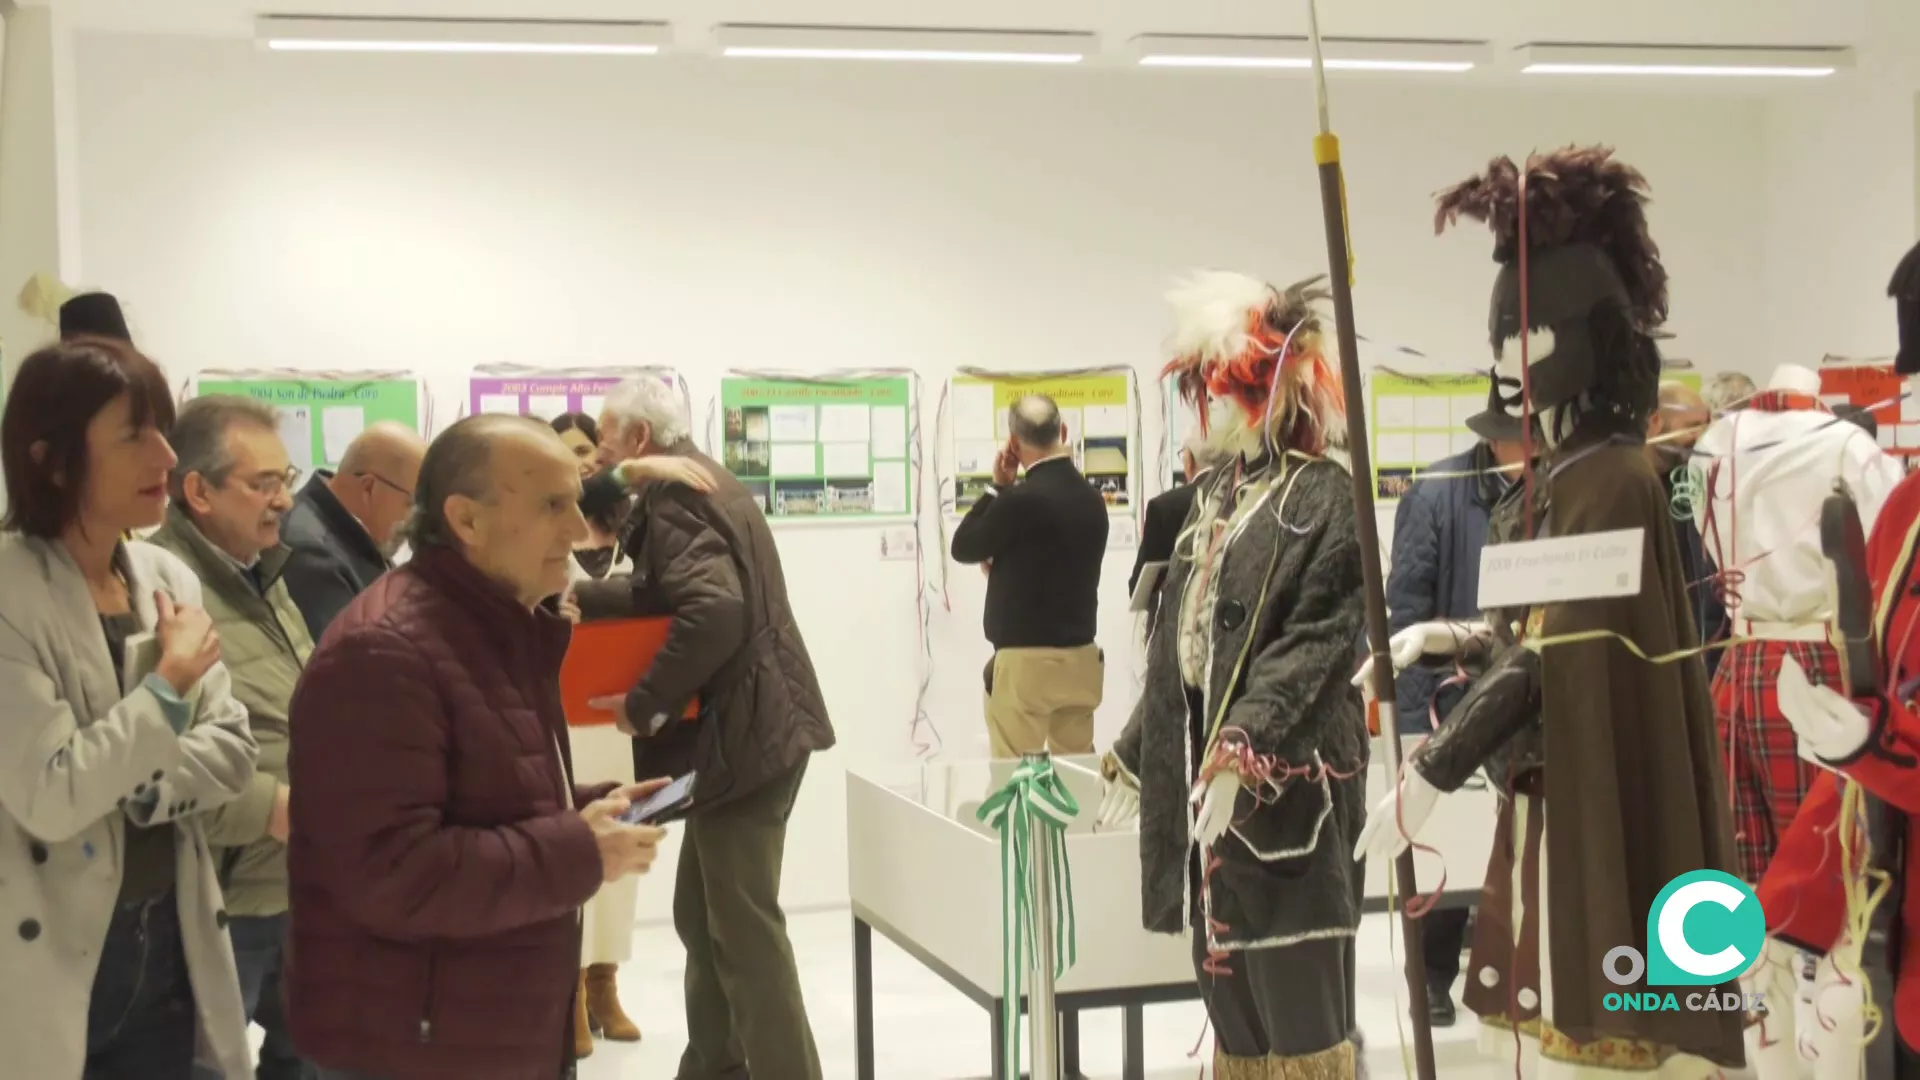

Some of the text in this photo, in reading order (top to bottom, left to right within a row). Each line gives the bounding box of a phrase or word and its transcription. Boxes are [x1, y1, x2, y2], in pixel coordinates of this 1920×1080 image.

[277, 386, 295, 399] Son
[313, 386, 345, 400] Piedra
[354, 387, 379, 400] Coro
[529, 382, 566, 395] Cumple
